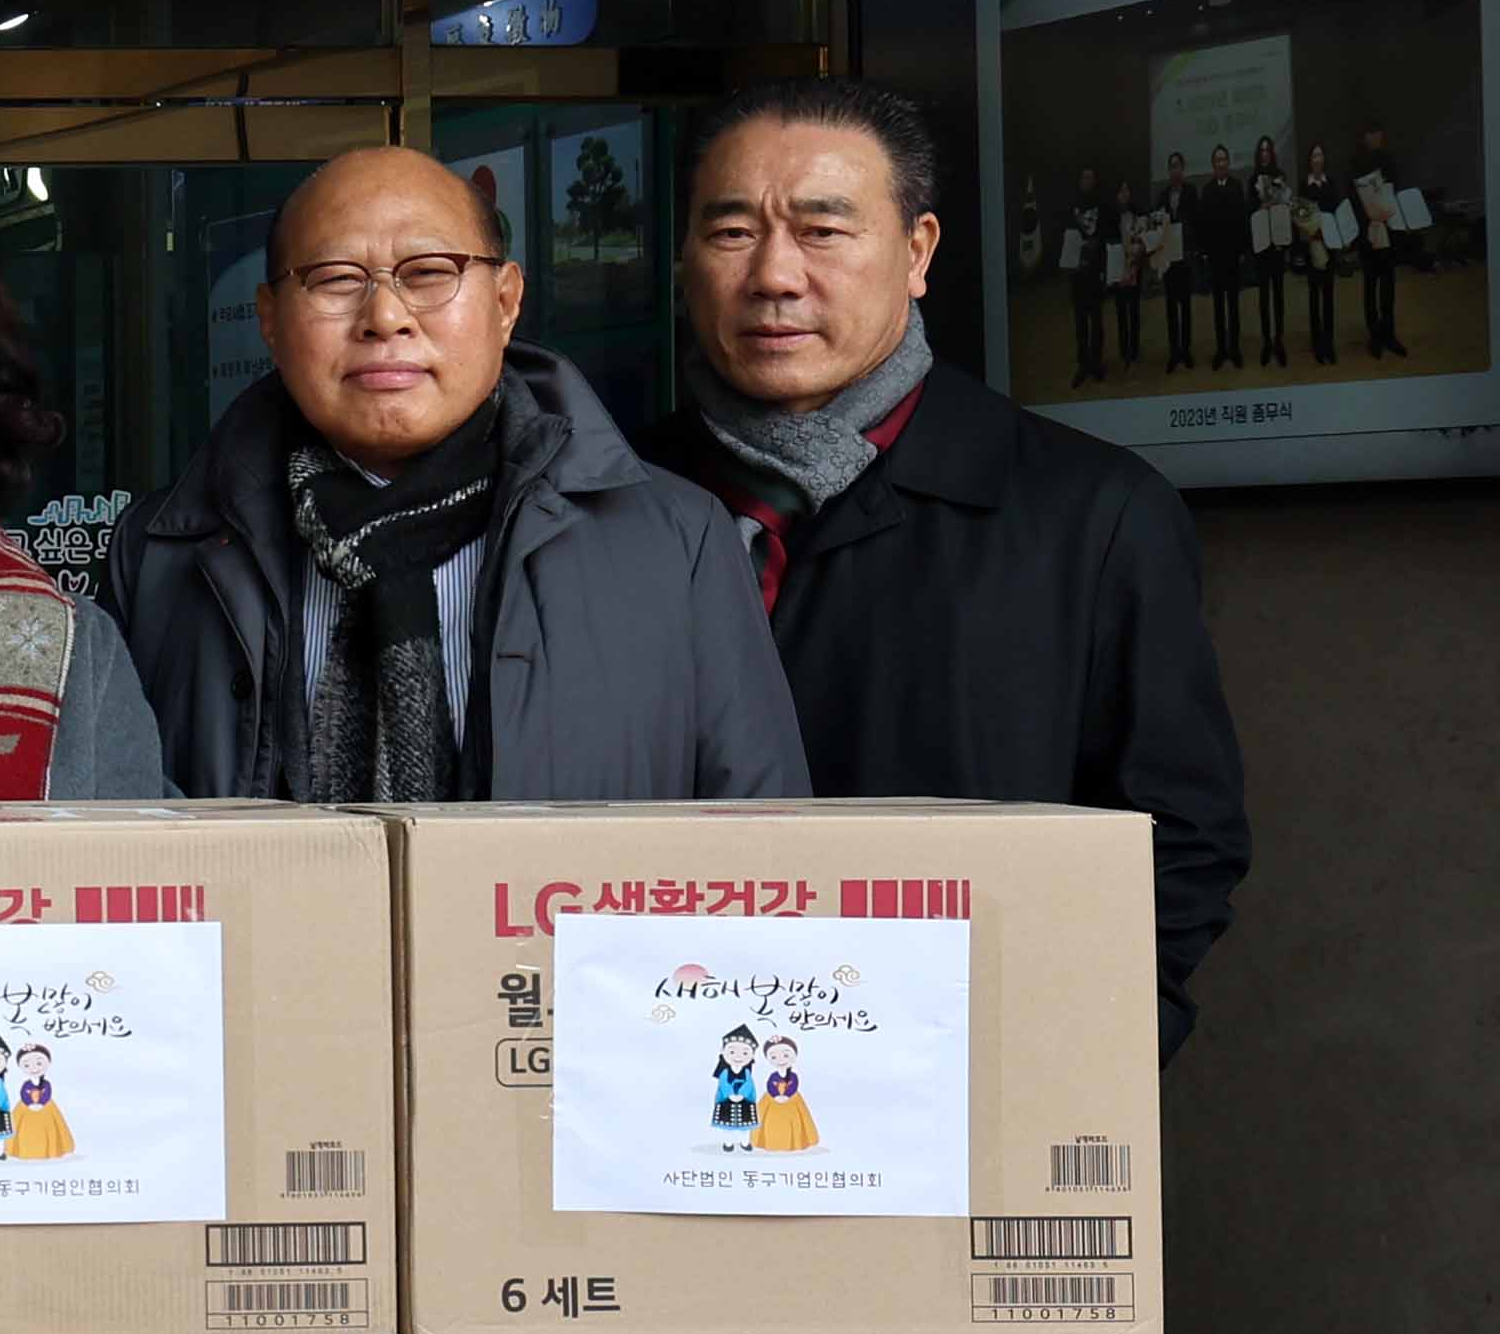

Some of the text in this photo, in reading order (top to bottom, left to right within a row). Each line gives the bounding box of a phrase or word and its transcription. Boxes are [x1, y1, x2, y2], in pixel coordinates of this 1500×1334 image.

[1170, 402, 1292, 428] 2023년 직원 종무식
[33, 527, 94, 565] 싶은
[654, 977, 741, 1002] 새해
[787, 1009, 880, 1034] 받으세요
[662, 1169, 884, 1190] 사단법인 동구기업인협의회
[502, 1276, 620, 1318] 6 세트
[224, 1312, 352, 1328] 11001758
[989, 1307, 1117, 1323] 11001758
